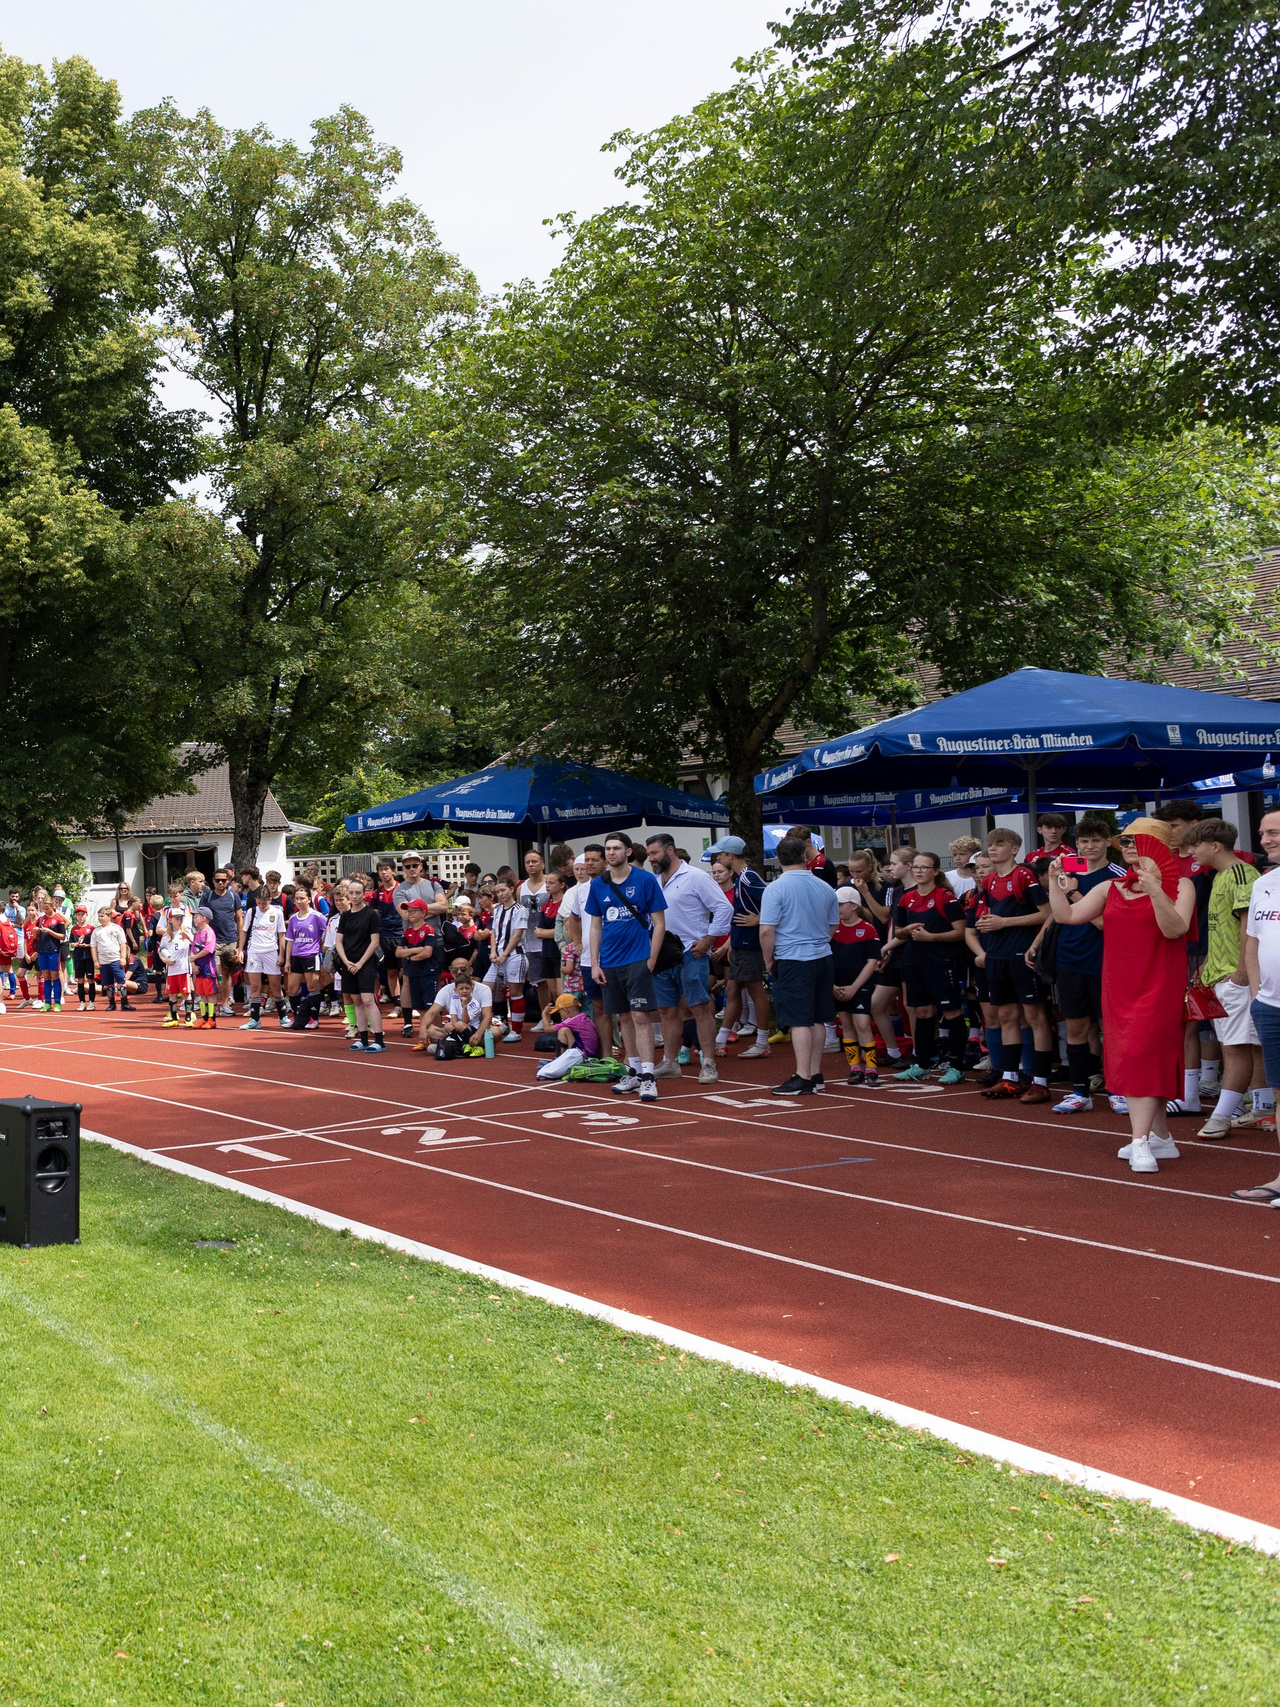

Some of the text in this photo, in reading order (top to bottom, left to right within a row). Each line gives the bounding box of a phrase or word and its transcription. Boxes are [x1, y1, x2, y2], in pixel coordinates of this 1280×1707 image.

[936, 732, 1094, 754] Augustiner-Bräu München
[701, 1095, 804, 1108] 4
[542, 1110, 640, 1126] 3
[380, 1126, 486, 1146] 2
[215, 1144, 292, 1162] 1
